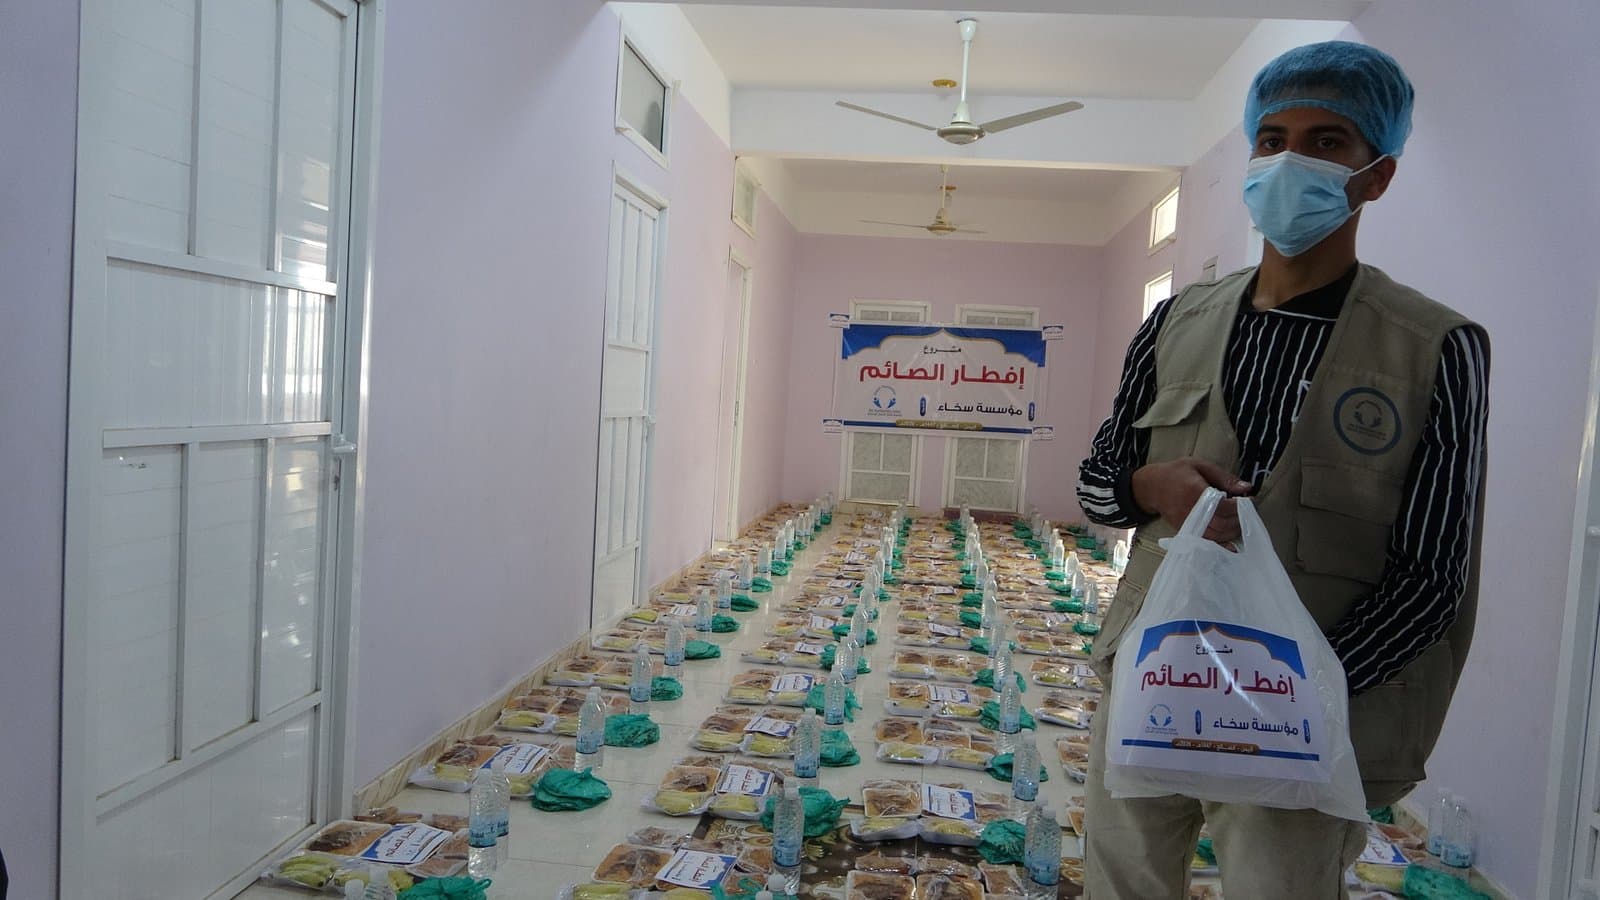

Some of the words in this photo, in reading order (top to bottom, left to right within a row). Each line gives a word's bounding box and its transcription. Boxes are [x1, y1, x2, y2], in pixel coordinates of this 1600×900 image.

[859, 361, 945, 382] الصائم
[951, 364, 1025, 390] إفطار
[937, 402, 974, 413] سخاء
[976, 402, 1023, 416] مؤسسة
[1141, 664, 1218, 691] الصائم
[1213, 717, 1249, 730] سخاء
[1252, 717, 1299, 736] مؤسسة
